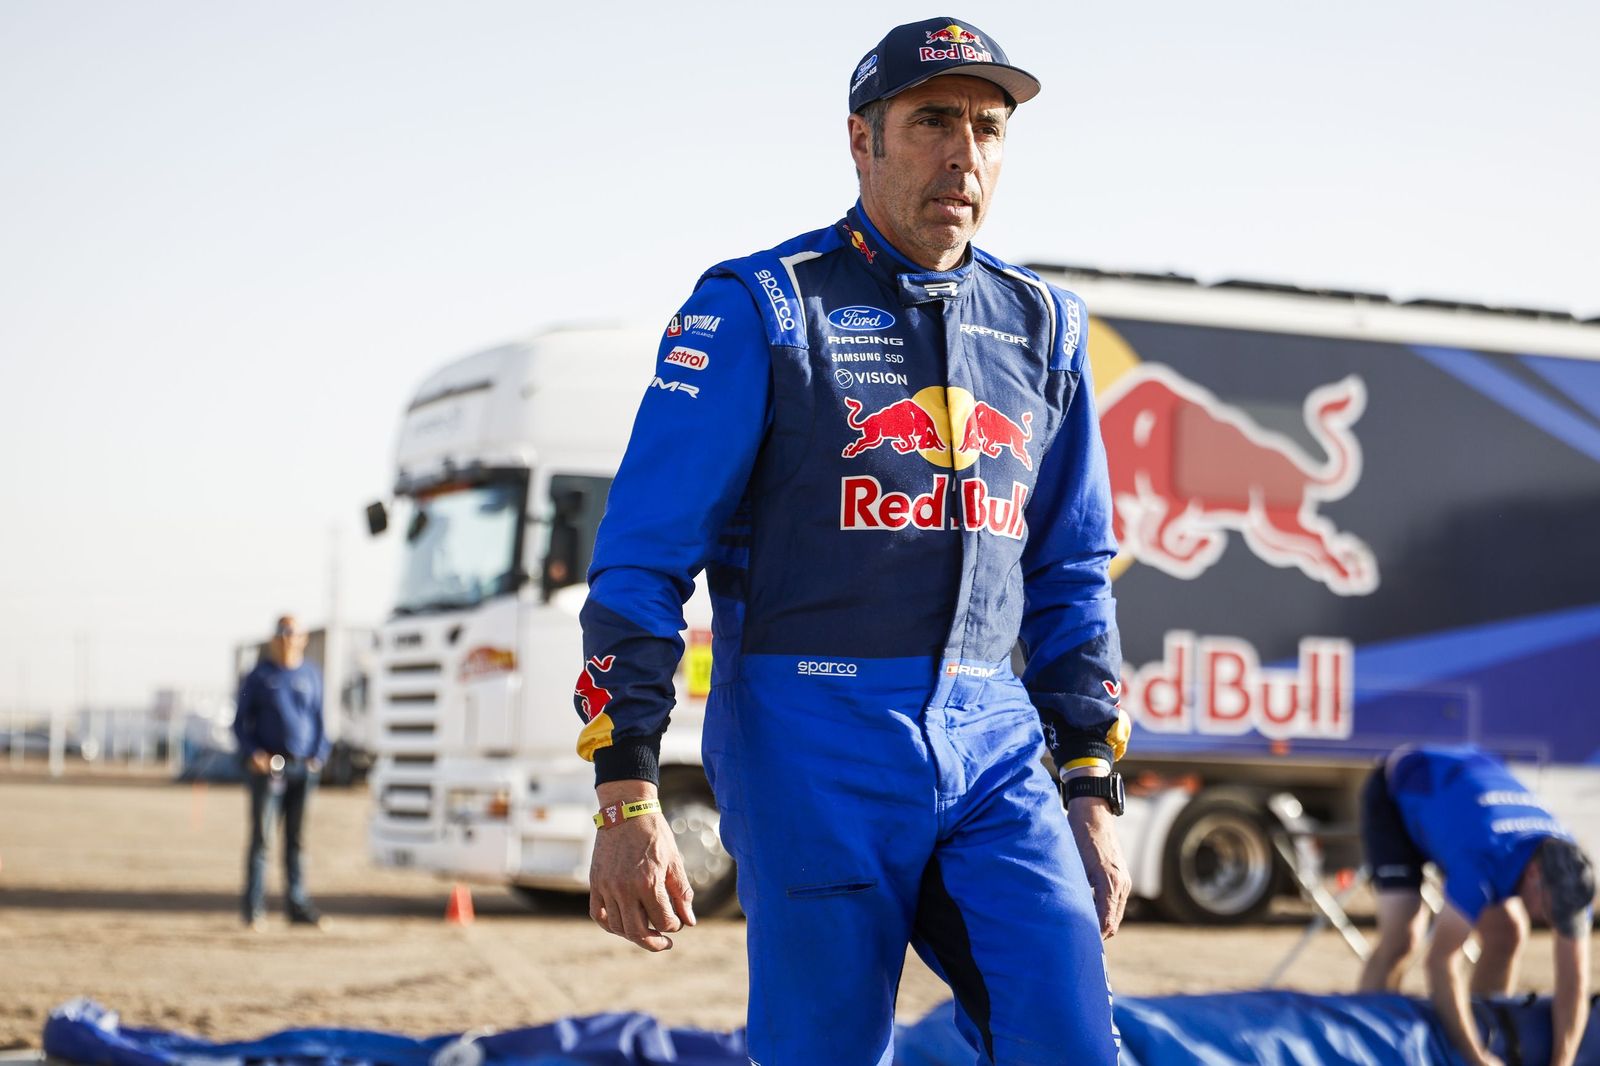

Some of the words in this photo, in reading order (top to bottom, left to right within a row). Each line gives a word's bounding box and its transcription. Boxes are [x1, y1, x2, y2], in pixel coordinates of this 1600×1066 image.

[919, 43, 960, 61] Red
[961, 44, 992, 62] Bull
[755, 269, 795, 333] sparco
[684, 315, 721, 332] OPTIMA
[840, 309, 882, 327] Ford
[960, 324, 1030, 348] RAPTOR
[1063, 299, 1080, 359] sparco
[828, 335, 904, 346] RACING
[667, 350, 706, 368] astrol
[831, 353, 881, 362] SAMSUNG
[885, 353, 904, 364] SSD
[650, 376, 700, 399] MR
[855, 372, 908, 386] VISION
[840, 474, 949, 531] Red
[797, 661, 858, 677] sparco
[958, 664, 998, 678] ROM
[1200, 641, 1350, 735] Bull
